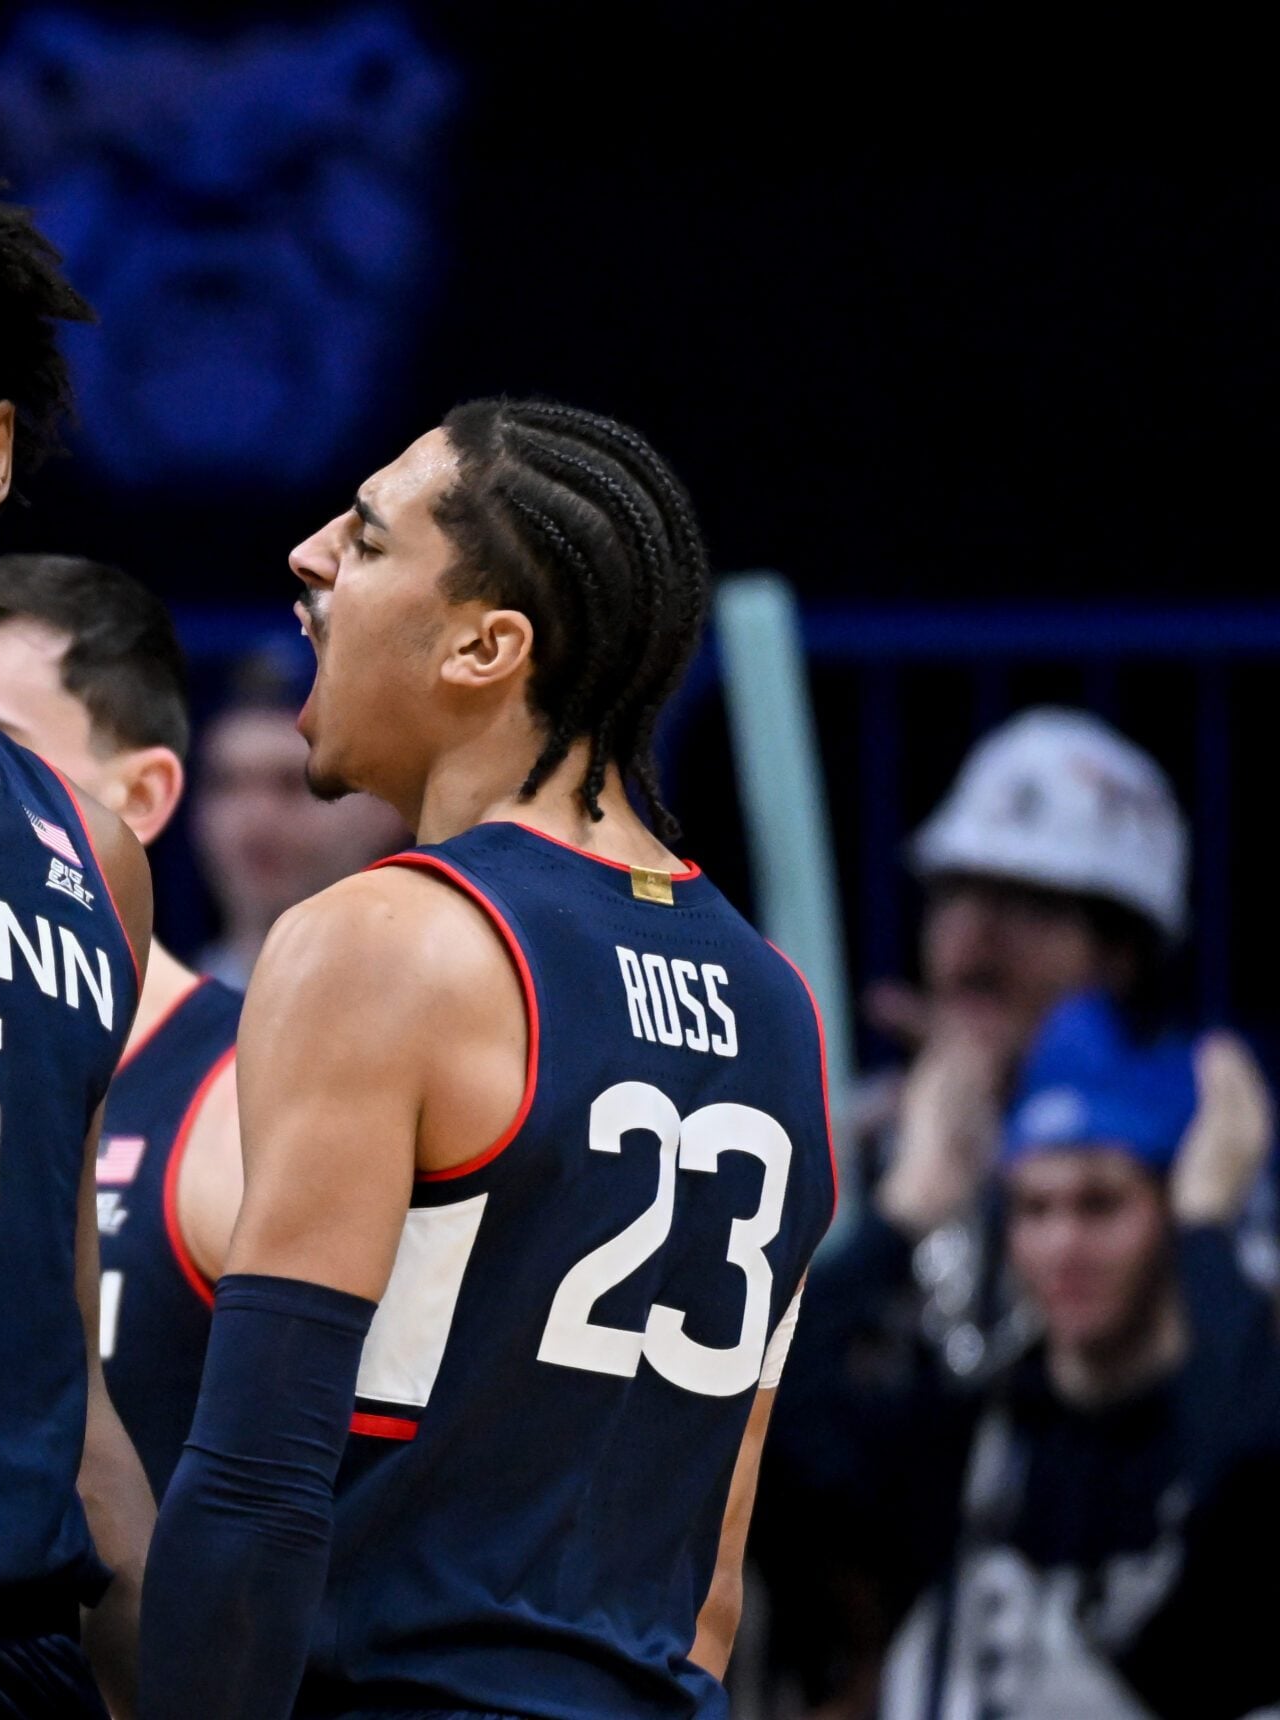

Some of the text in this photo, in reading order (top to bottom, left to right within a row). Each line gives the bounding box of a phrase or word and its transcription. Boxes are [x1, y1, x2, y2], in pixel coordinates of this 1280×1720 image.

[48, 869, 95, 904] EAST
[50, 857, 83, 885] BIG
[615, 945, 738, 1058] ROSS
[536, 1080, 793, 1397] 23
